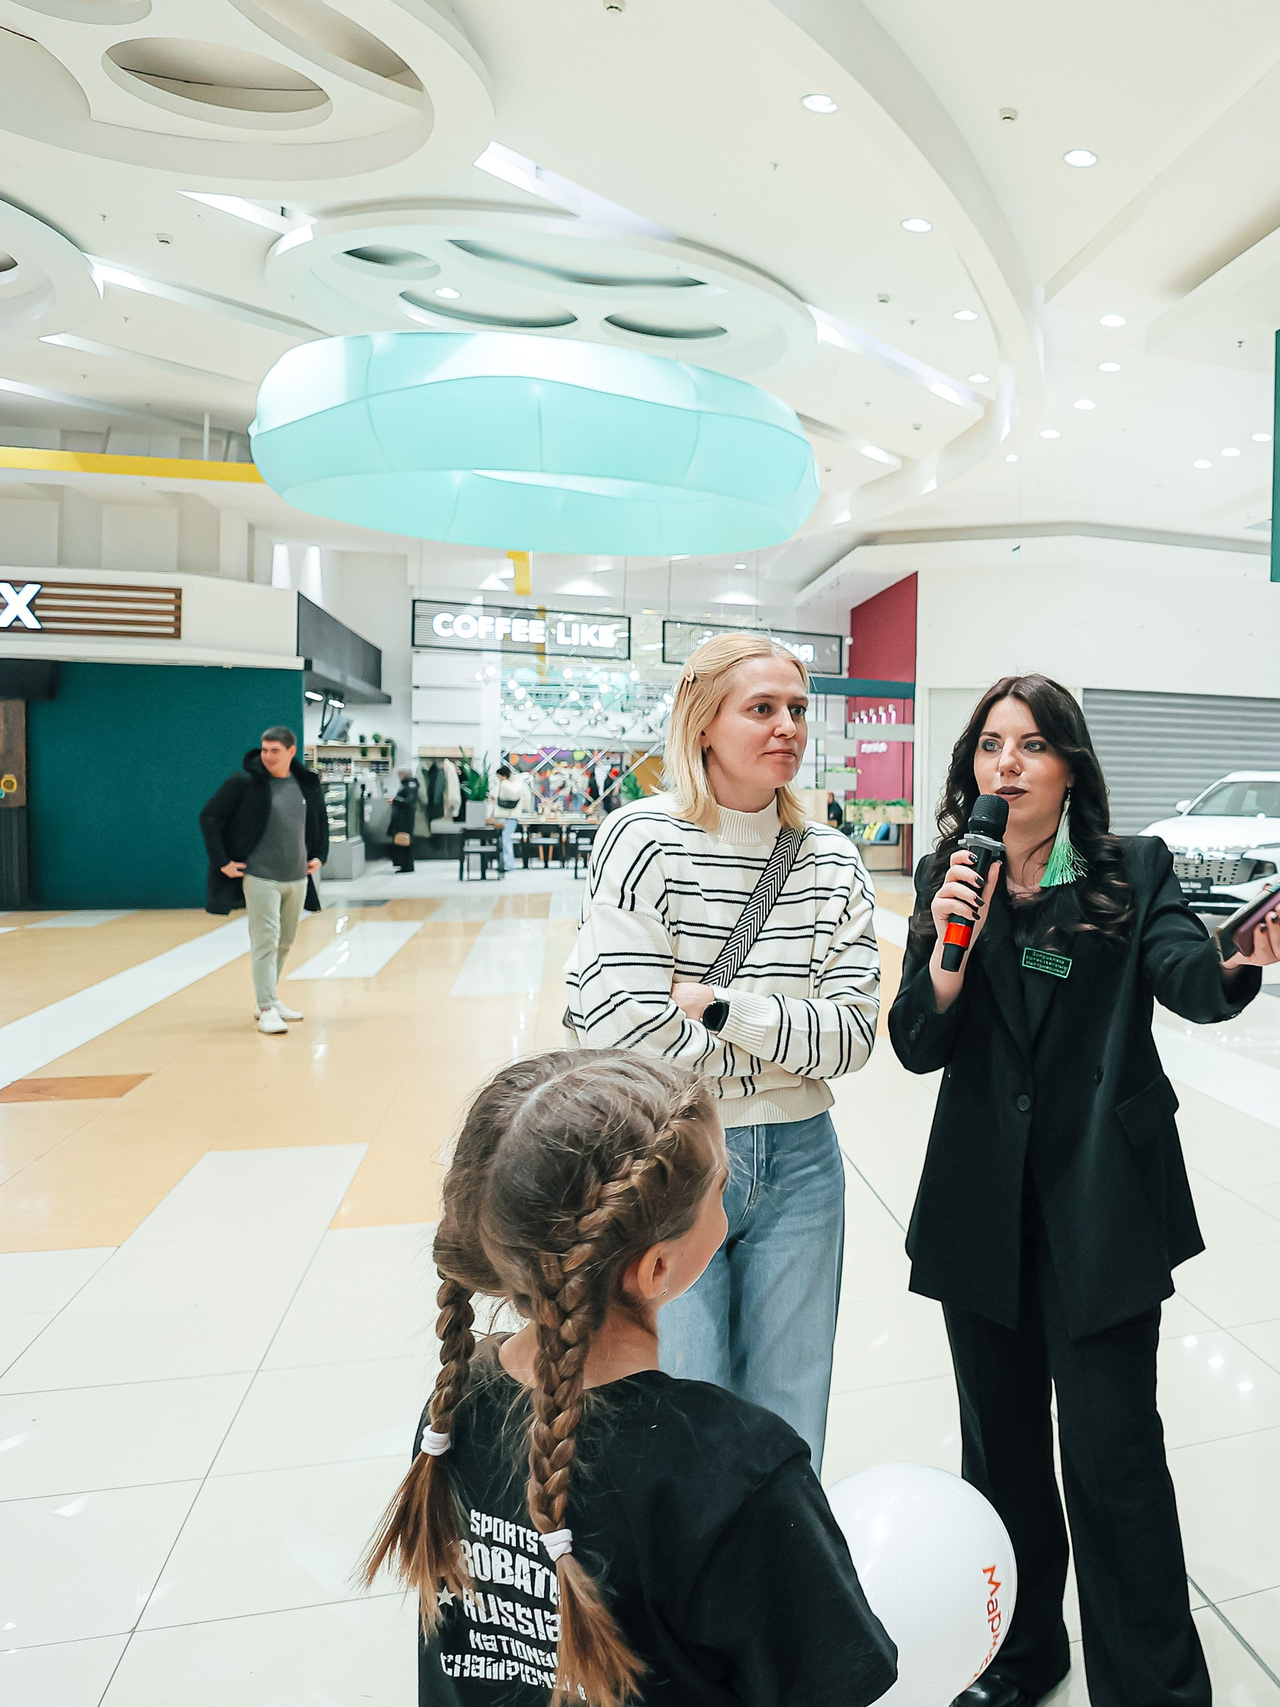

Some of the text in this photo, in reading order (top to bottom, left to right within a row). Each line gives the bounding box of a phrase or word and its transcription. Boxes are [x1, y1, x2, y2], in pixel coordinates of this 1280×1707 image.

[432, 612, 618, 649] COFFEE LIKE
[470, 1508, 539, 1555] SPORTS
